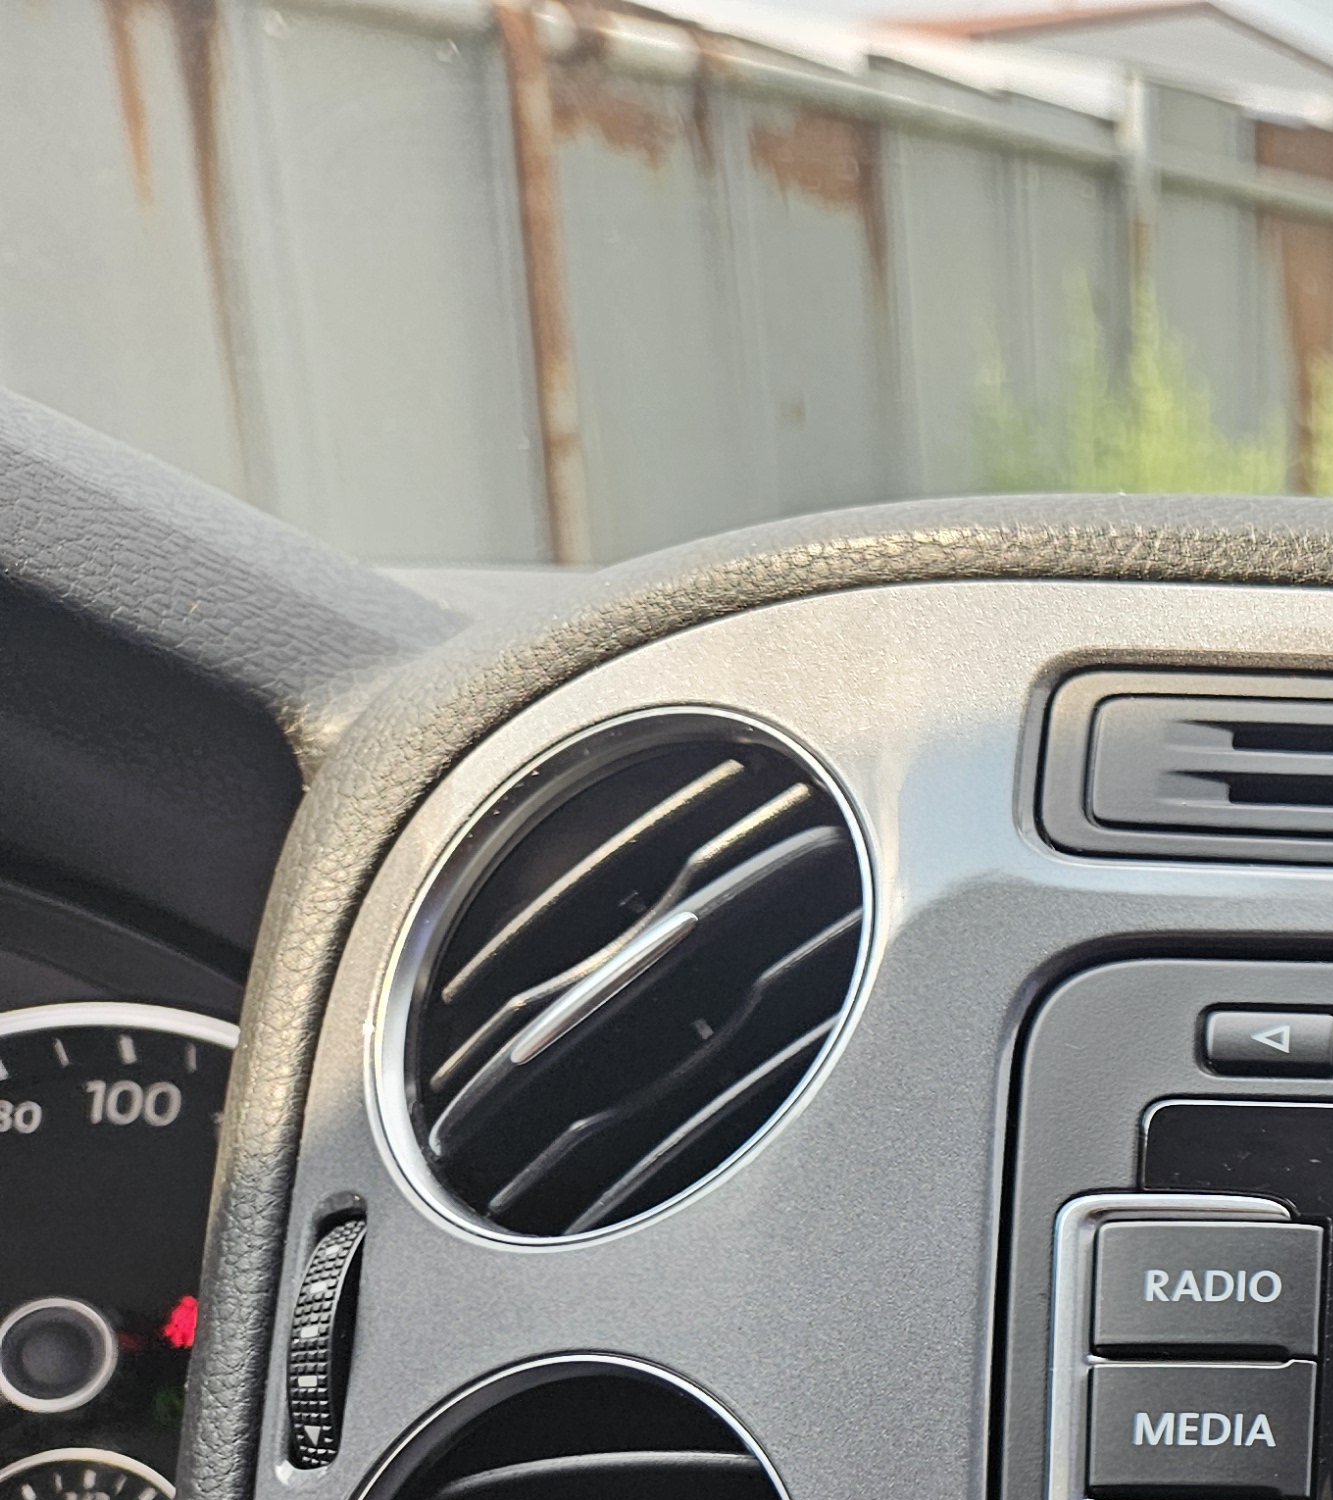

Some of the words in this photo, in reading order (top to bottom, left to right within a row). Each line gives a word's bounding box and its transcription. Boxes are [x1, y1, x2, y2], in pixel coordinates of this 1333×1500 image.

[85, 1079, 182, 1127] 100
[1145, 1269, 1282, 1303] RADIO
[1134, 1412, 1276, 1448] MEDIA
